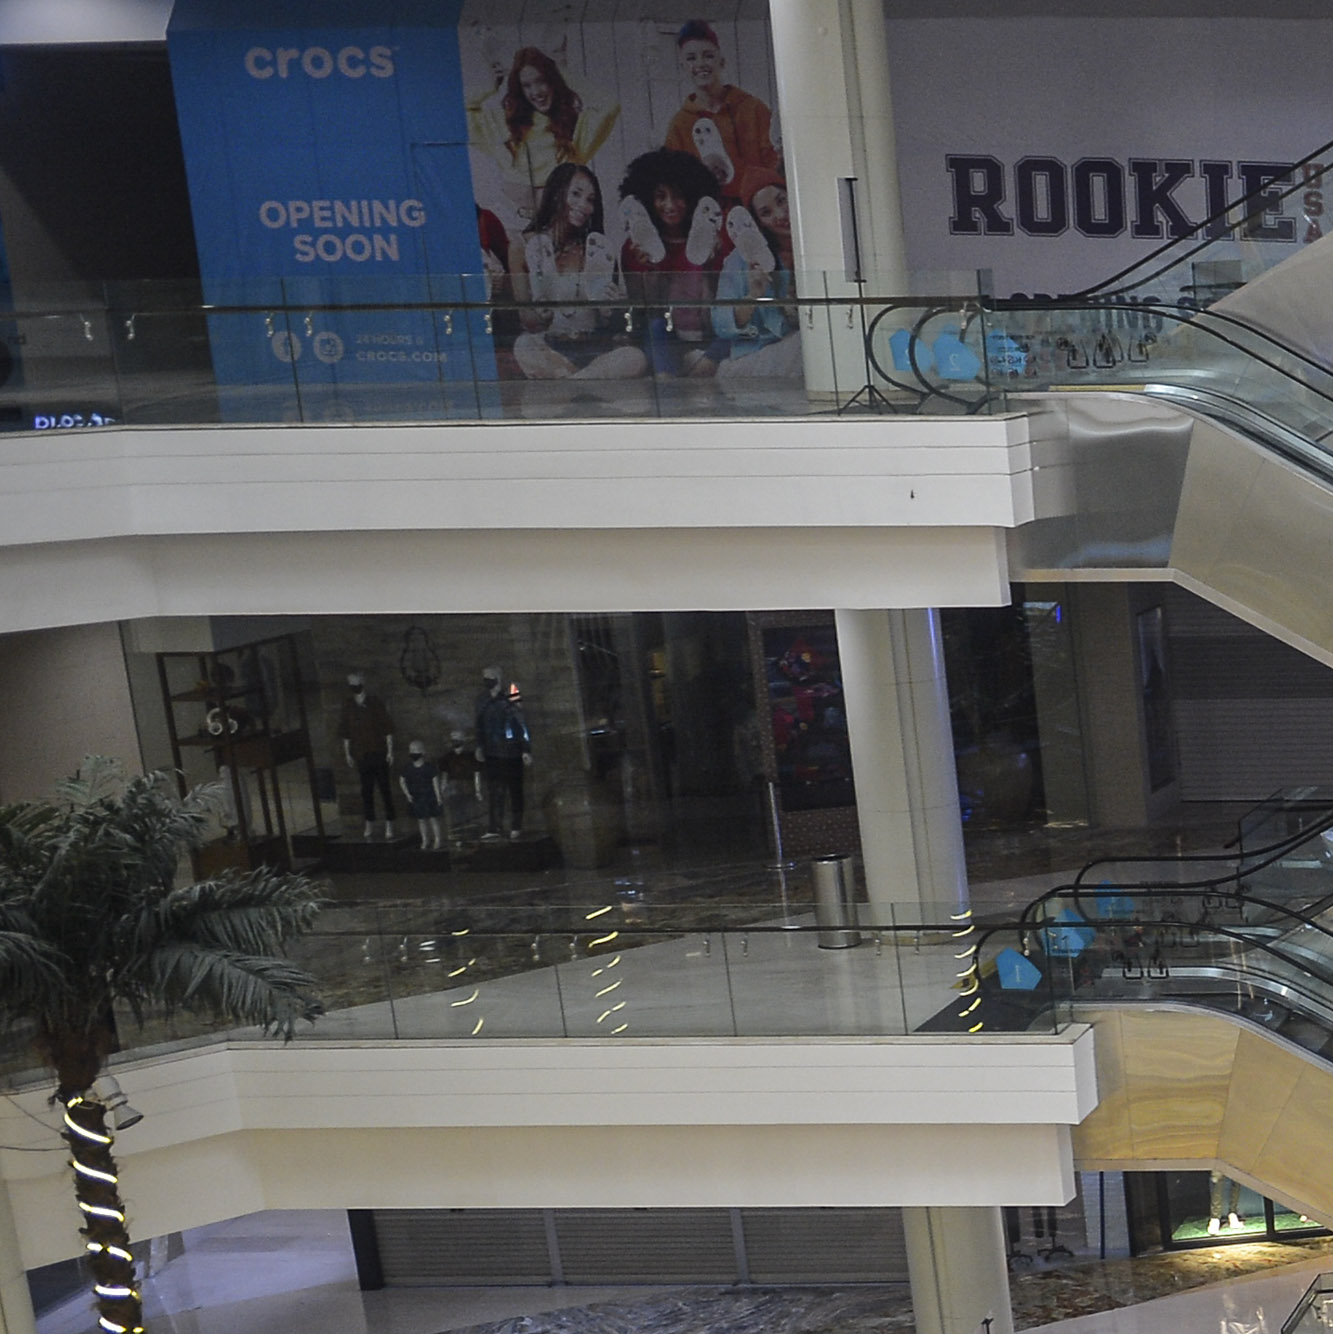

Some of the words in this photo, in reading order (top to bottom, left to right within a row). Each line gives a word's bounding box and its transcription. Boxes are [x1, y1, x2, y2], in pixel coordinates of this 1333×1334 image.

[245, 46, 395, 79] crocs
[259, 199, 426, 228] OPENING
[945, 153, 1297, 243] ROOKIE
[293, 233, 399, 262] SOON
